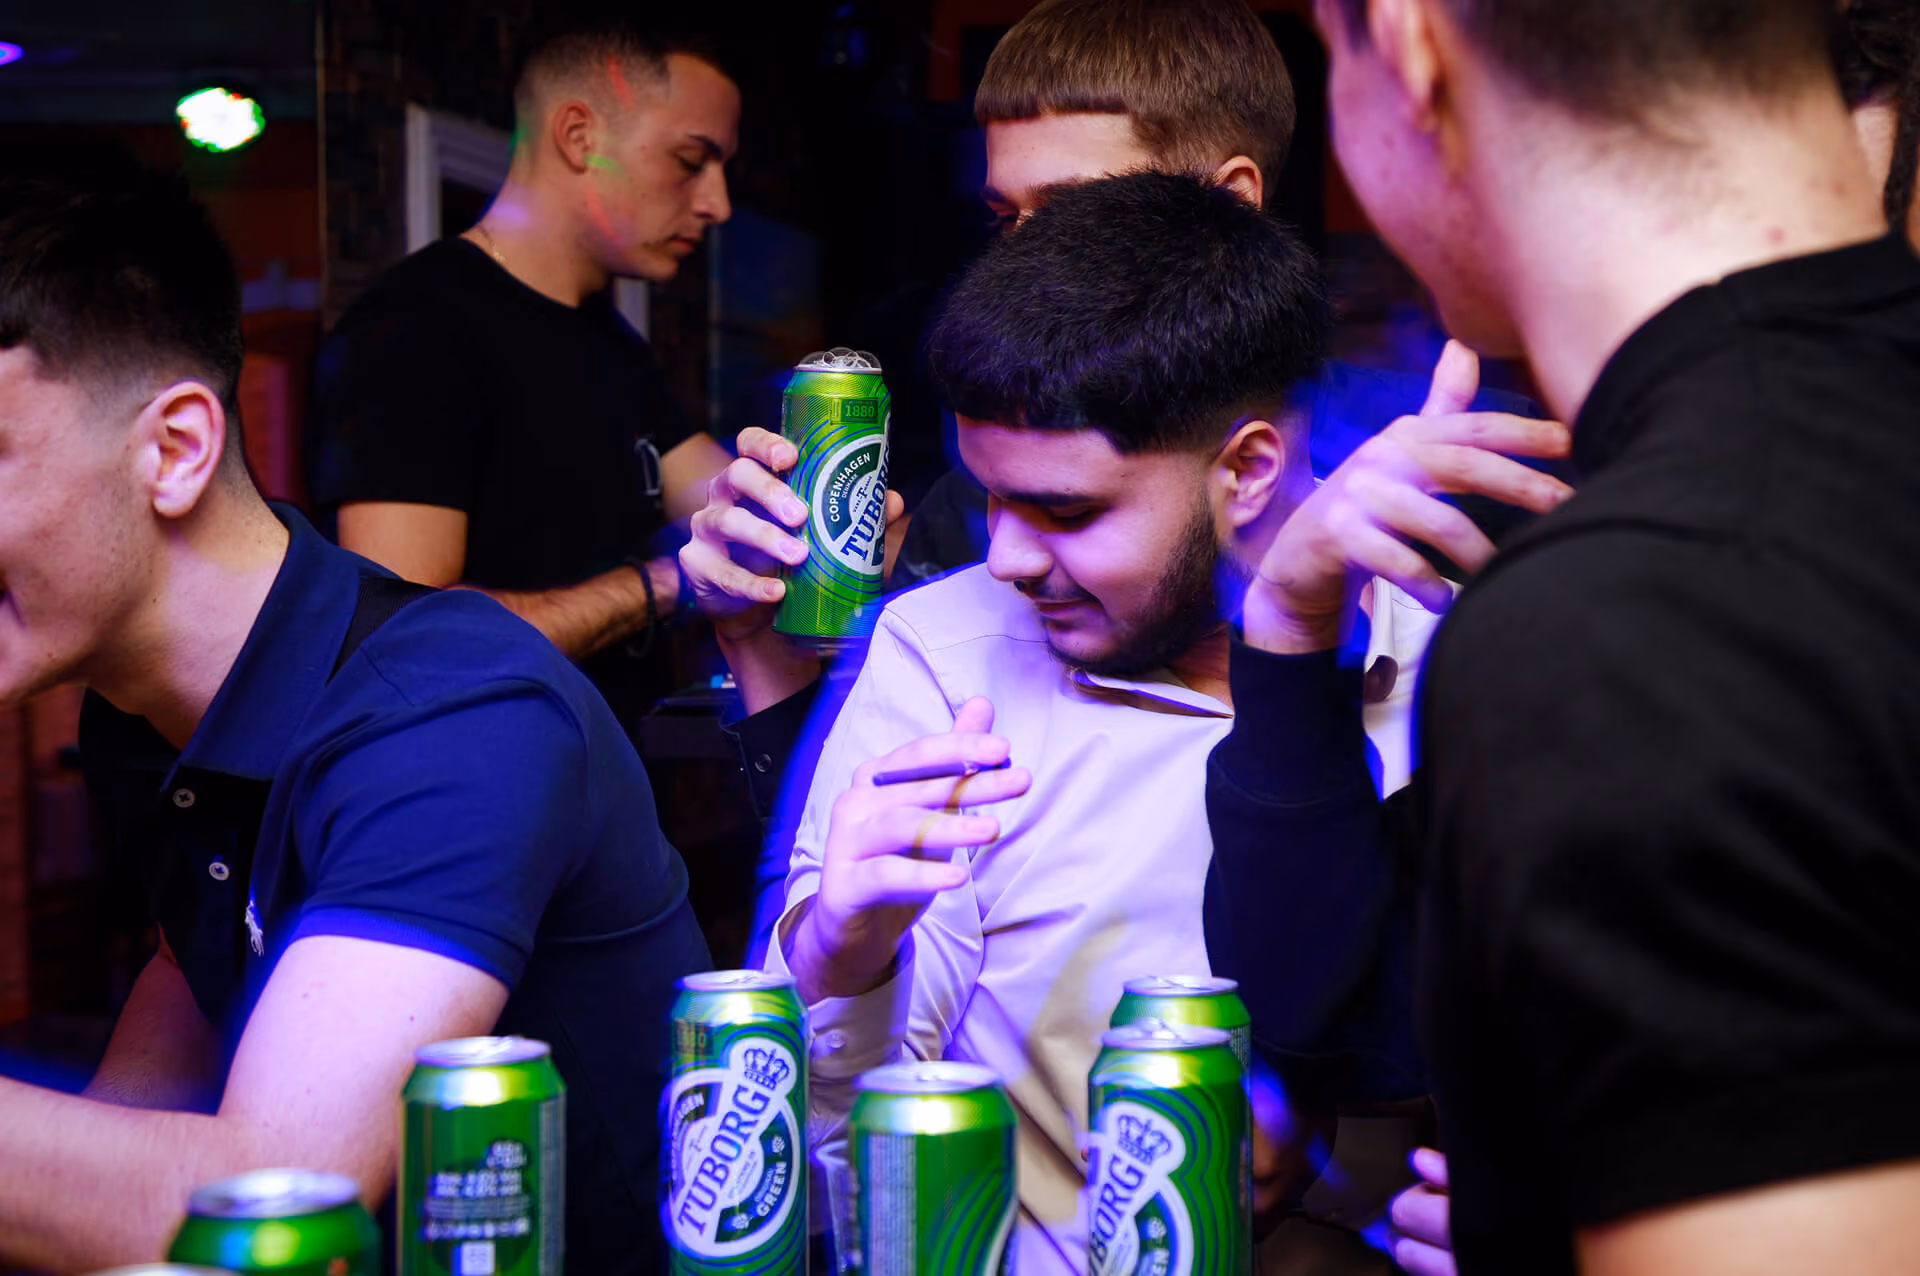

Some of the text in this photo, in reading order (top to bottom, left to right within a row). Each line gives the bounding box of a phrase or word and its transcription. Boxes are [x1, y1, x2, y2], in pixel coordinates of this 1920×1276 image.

[845, 404, 875, 417] 1880
[829, 452, 871, 523] COPENHAGEN
[678, 1083, 770, 1236] TUBORG
[756, 1161, 787, 1217] GREEN
[1088, 1155, 1146, 1276] BORG
